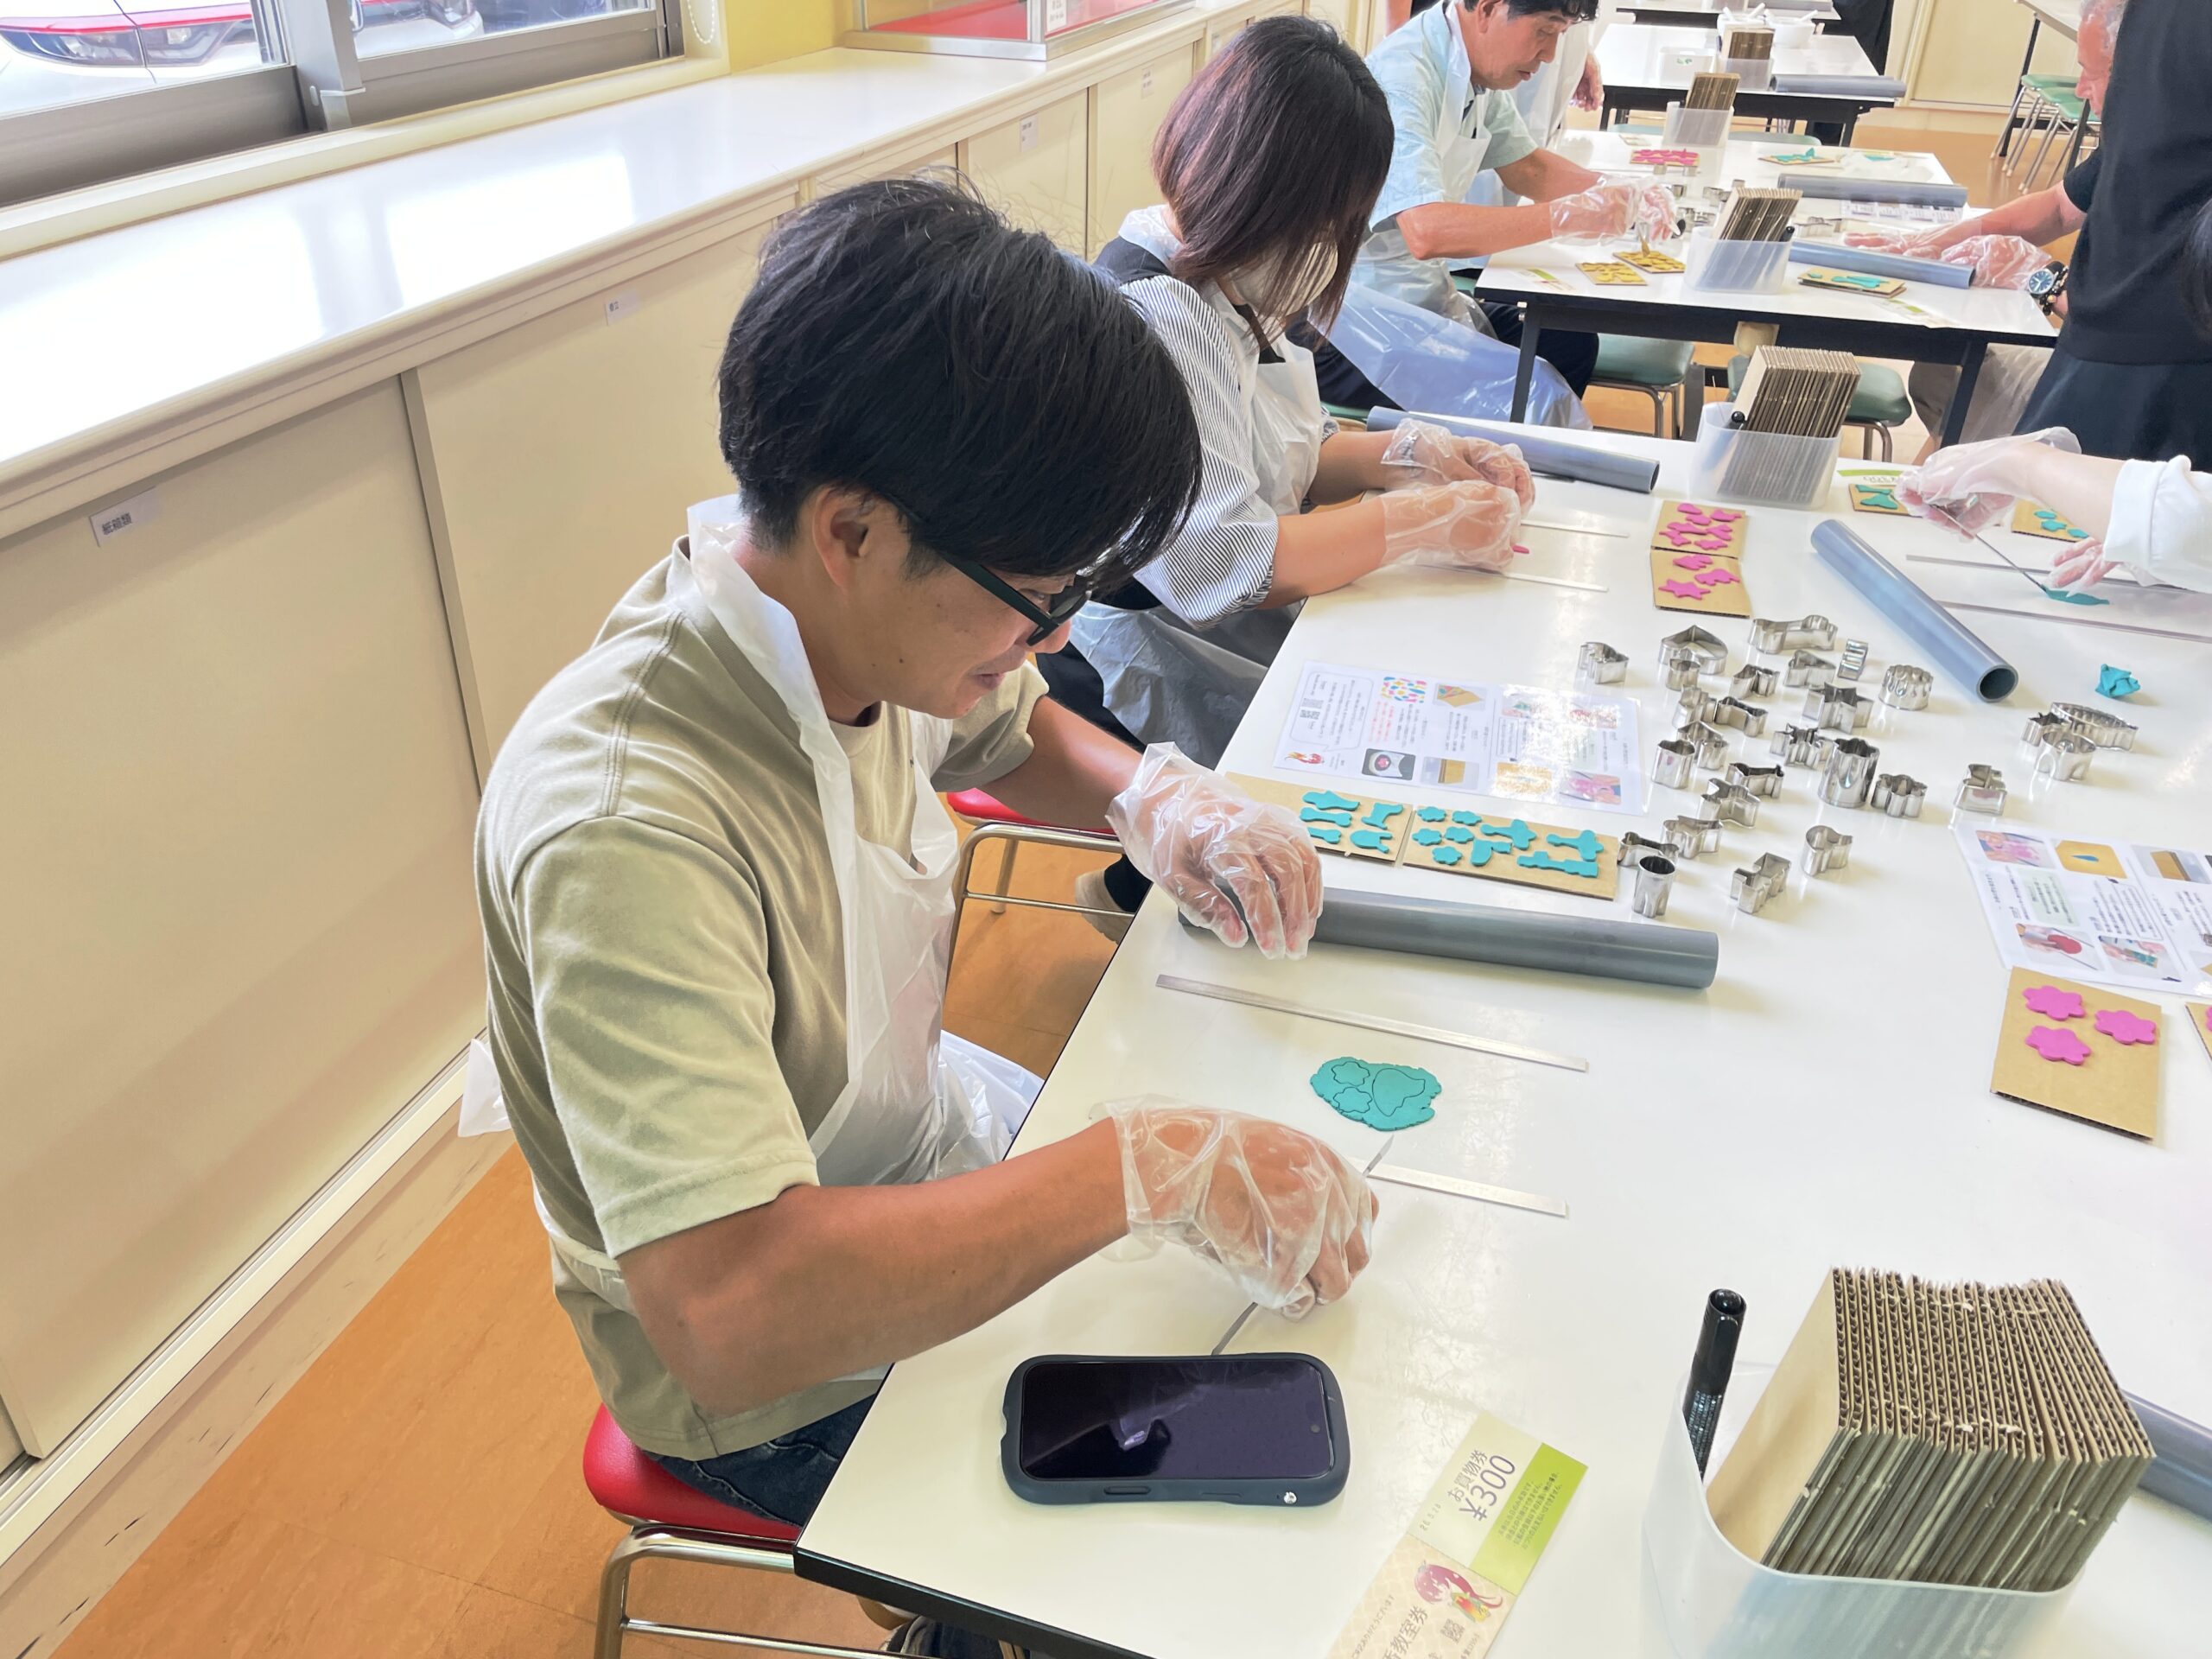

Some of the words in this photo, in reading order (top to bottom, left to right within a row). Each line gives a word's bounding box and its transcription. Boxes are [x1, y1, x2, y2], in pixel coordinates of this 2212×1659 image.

[1447, 1449, 1488, 1503] お買物券
[1459, 1455, 1516, 1522] ¥300
